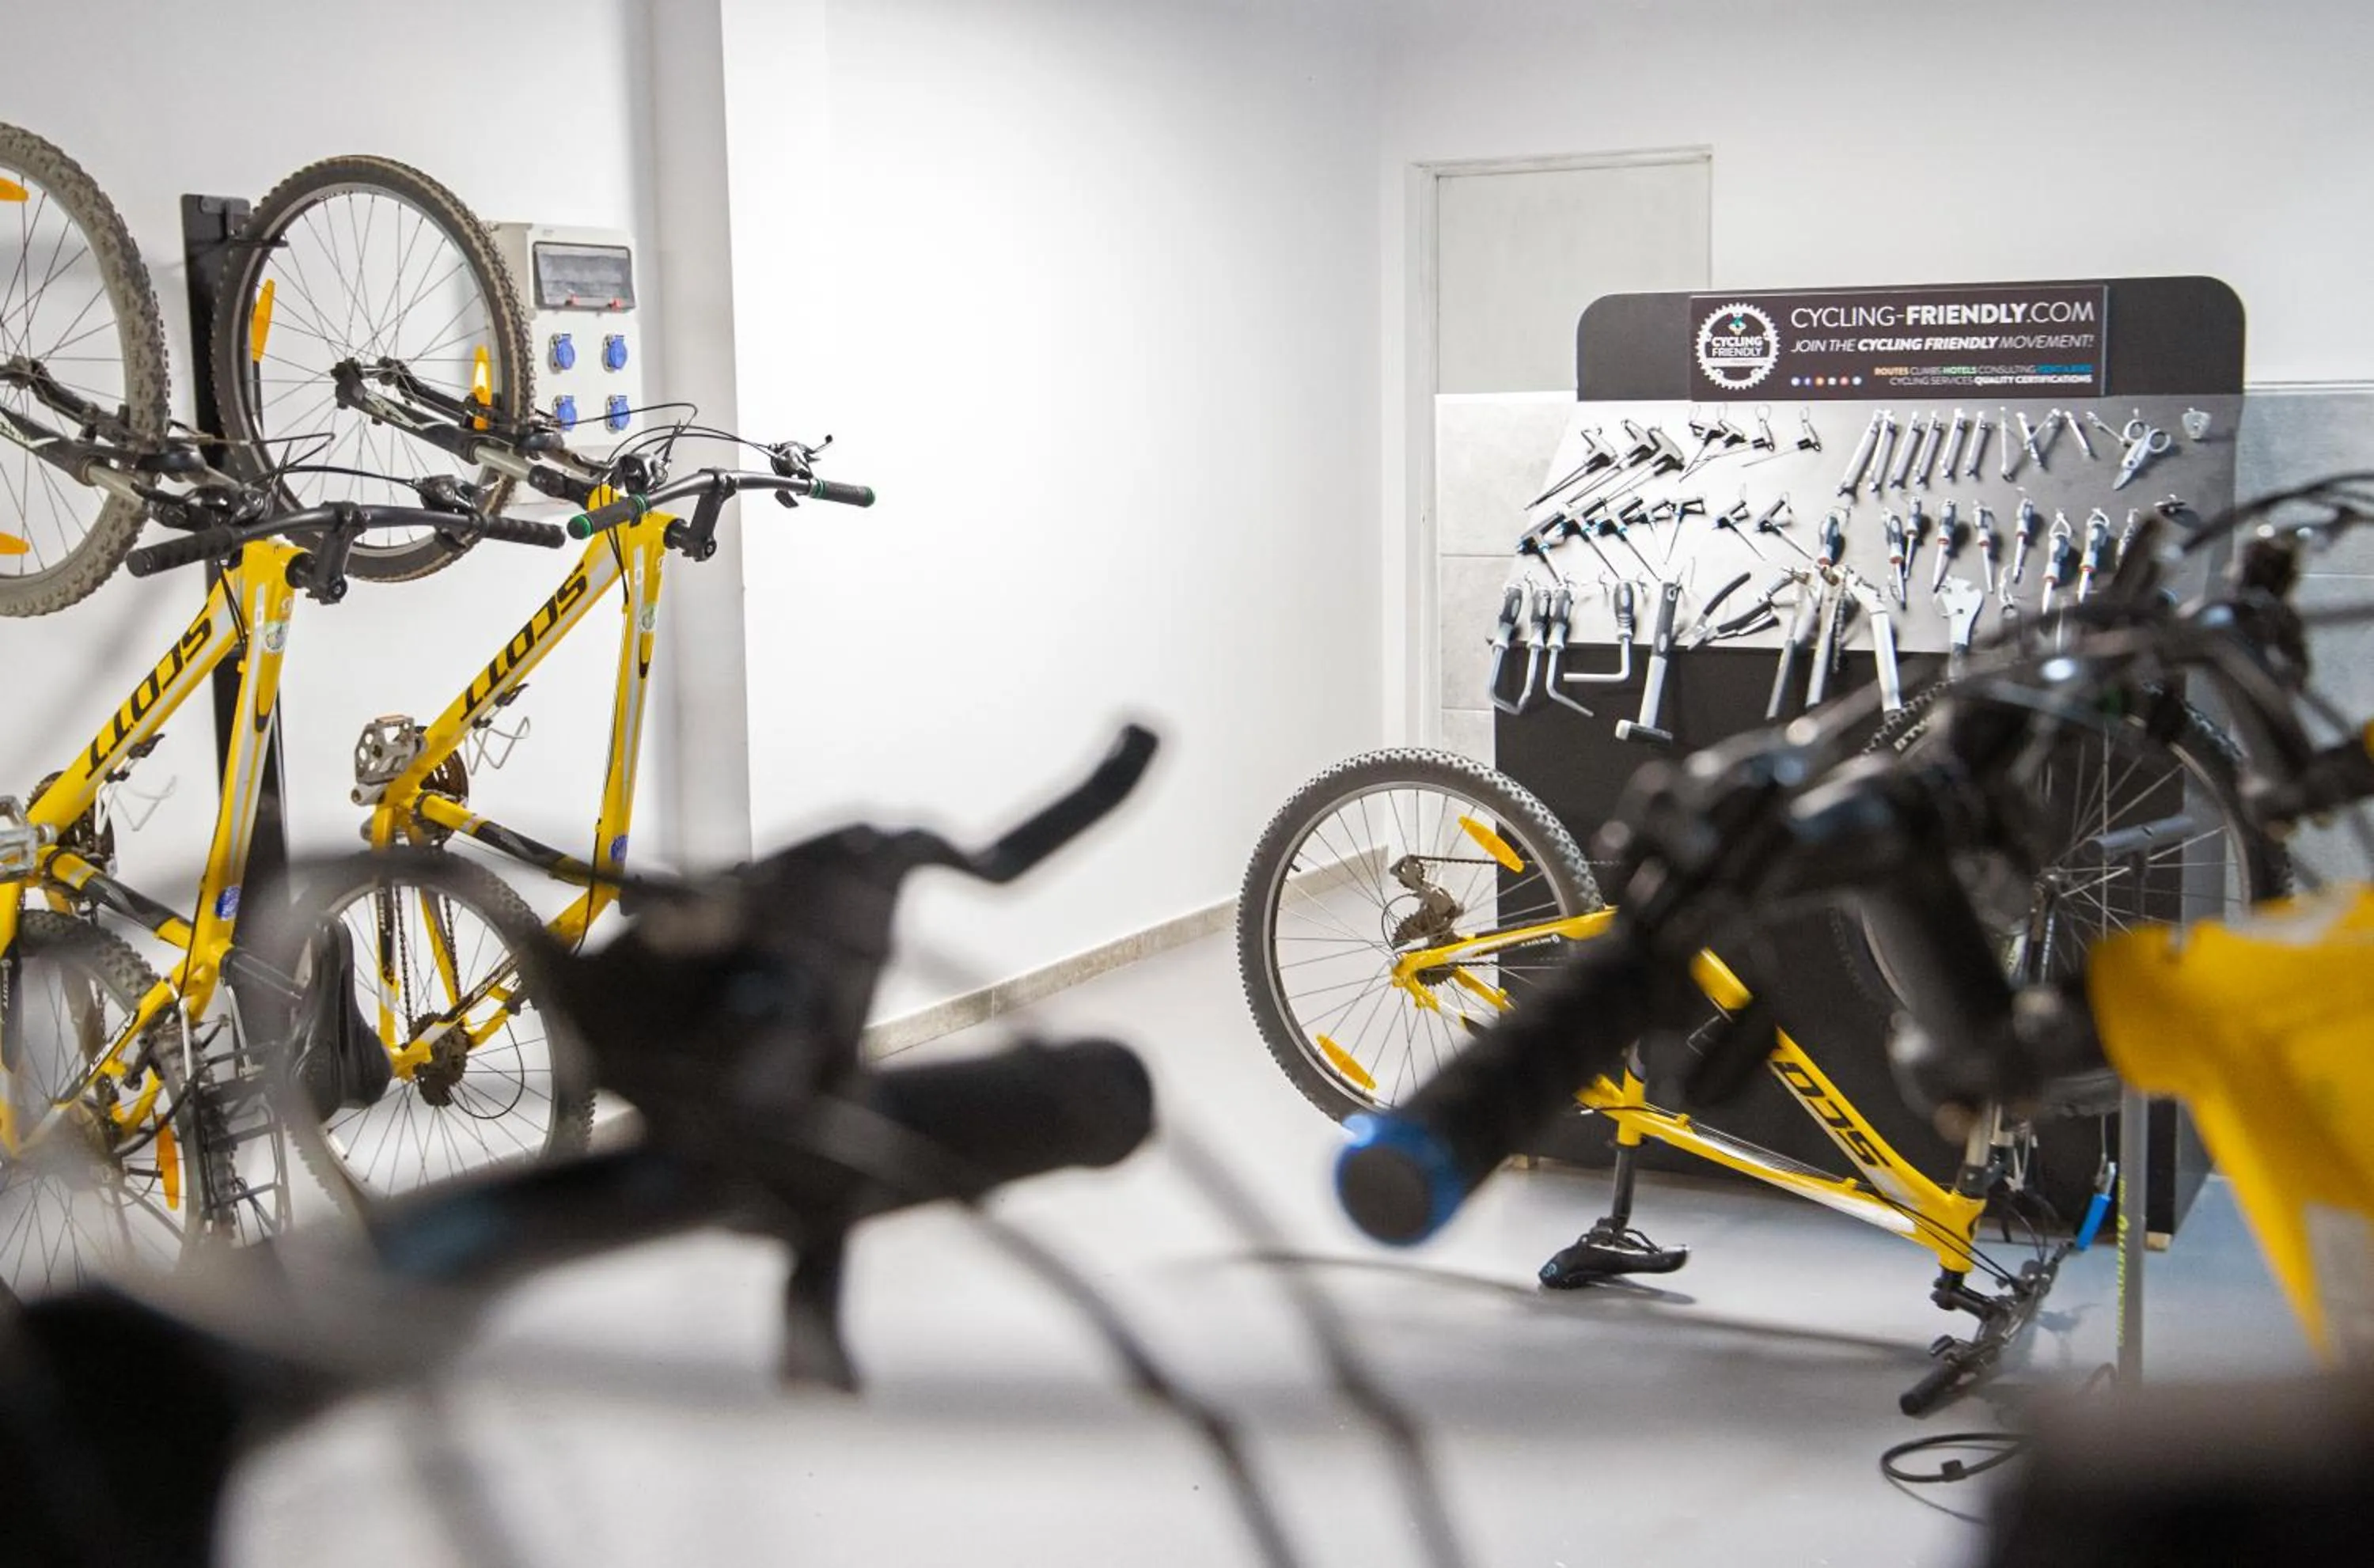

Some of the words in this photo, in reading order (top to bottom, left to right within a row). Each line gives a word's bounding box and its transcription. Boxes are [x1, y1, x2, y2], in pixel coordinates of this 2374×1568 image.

[1791, 301, 2095, 328] CYCLING-FRIENDLY.COM
[1712, 336, 1764, 347] CYCLING
[1712, 347, 1762, 357] FRIENDLY
[1791, 339, 1826, 353] JOIN
[1828, 339, 1856, 352] THE
[1857, 338, 1923, 351] CYCLING
[1924, 336, 1999, 350] FRIENDLY
[1998, 334, 2095, 349] MOVEMENT!
[1875, 366, 1909, 376] ROUTES
[1943, 365, 1977, 374] HOTELS
[457, 561, 587, 722] SCOTT
[85, 604, 211, 780] SCOTT
[1772, 1062, 1892, 1167] SCO
